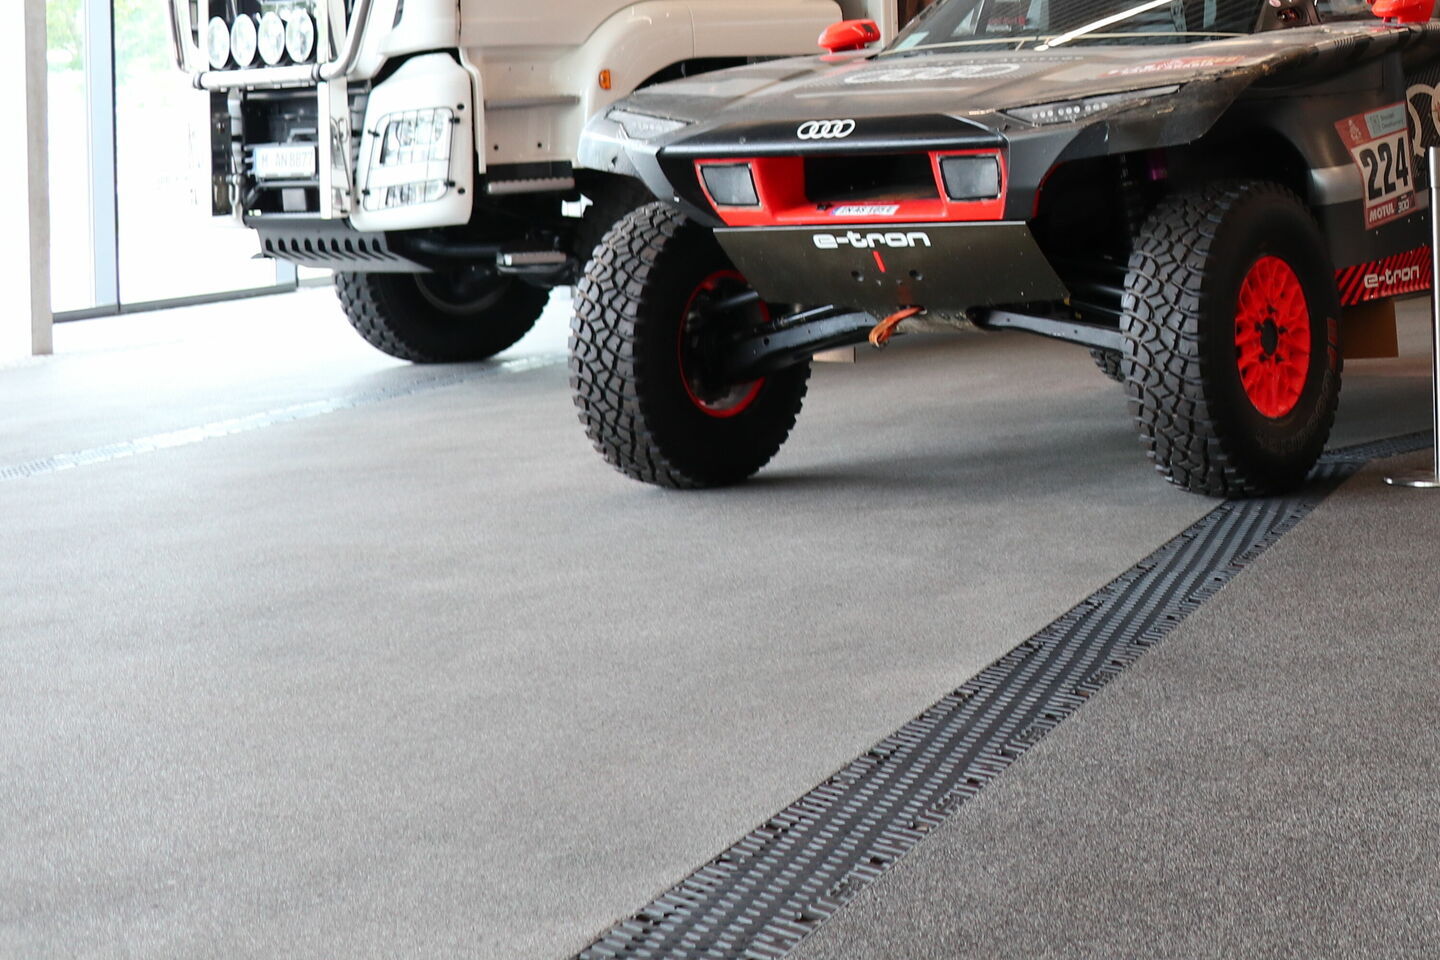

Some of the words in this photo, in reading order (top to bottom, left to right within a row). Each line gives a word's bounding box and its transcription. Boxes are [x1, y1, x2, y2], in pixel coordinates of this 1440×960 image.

[1358, 137, 1409, 201] 224
[1369, 202, 1395, 223] MOTUL
[812, 230, 932, 249] e-tron
[1364, 265, 1420, 289] e-tron
